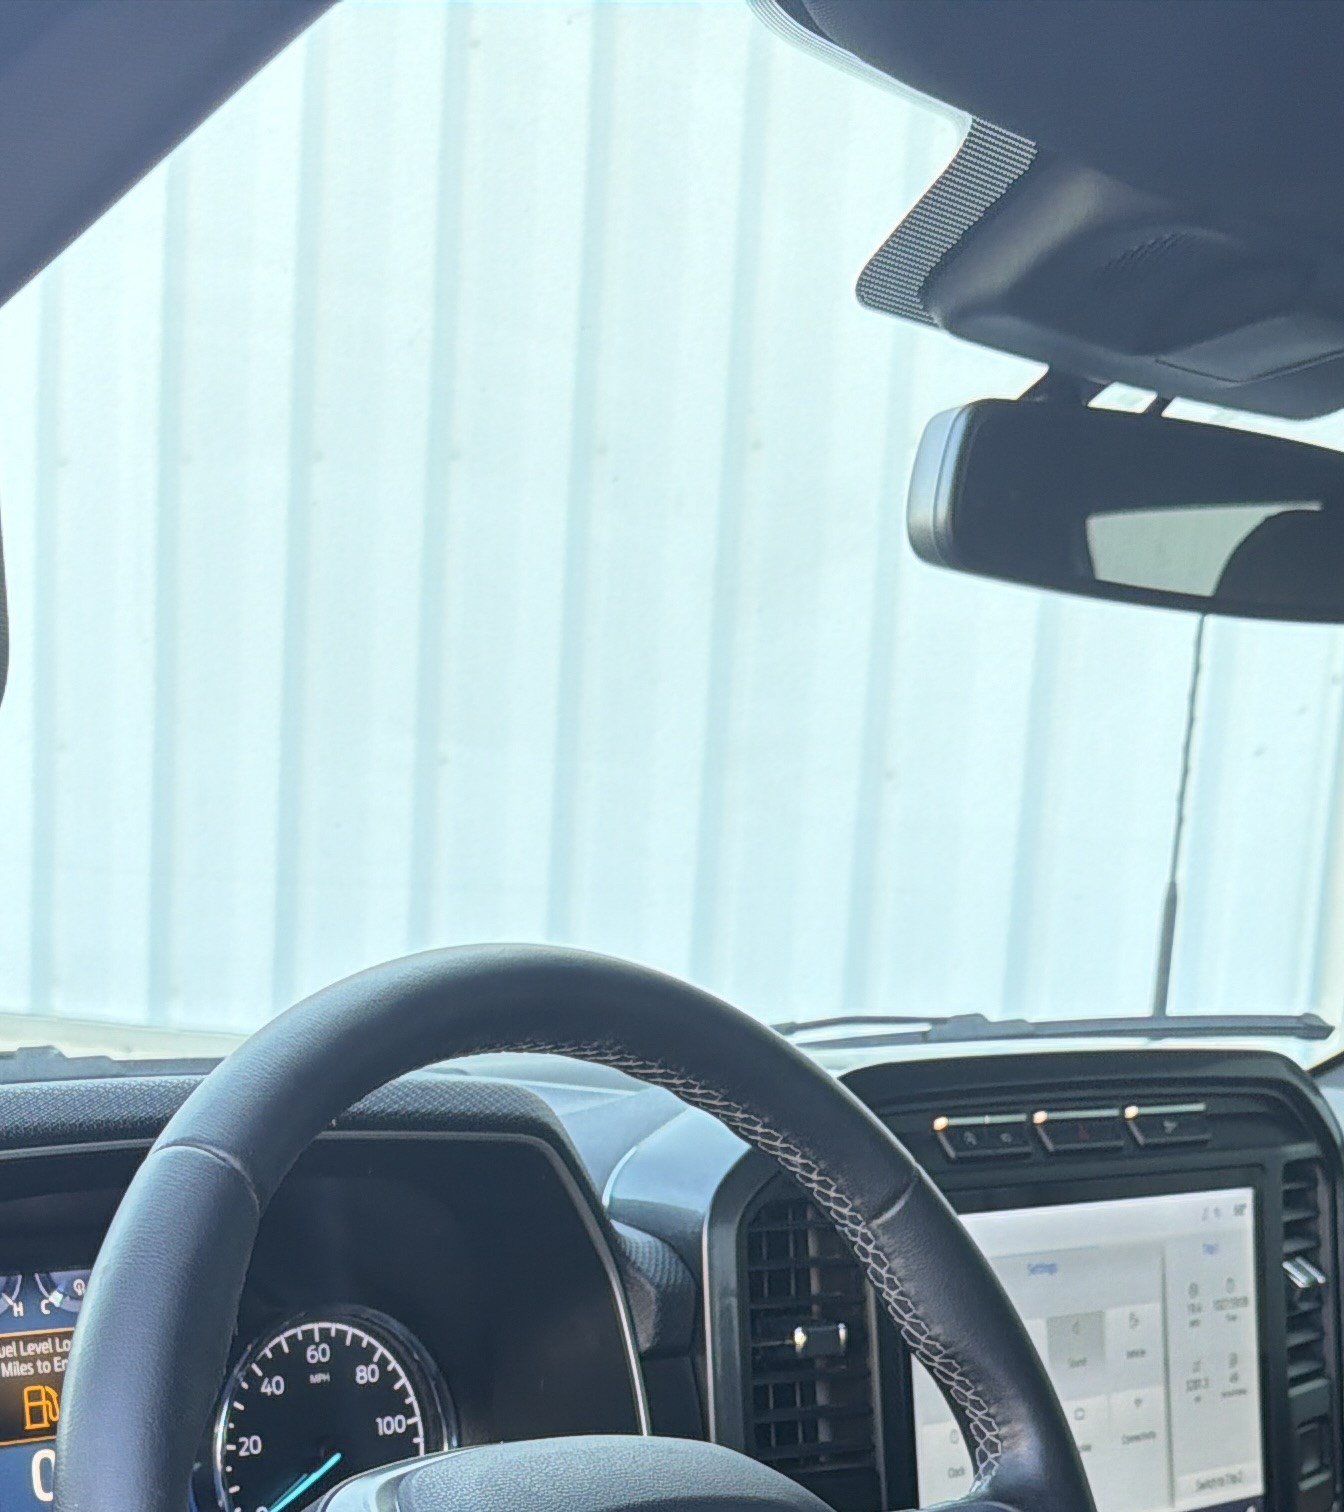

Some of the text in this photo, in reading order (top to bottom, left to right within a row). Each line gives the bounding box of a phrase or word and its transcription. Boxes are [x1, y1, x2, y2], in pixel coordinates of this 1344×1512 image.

[13, 1302, 24, 1317] H
[40, 1300, 51, 1315] C
[19, 1338, 53, 1356] Level
[55, 1337, 71, 1352] Lo
[306, 1343, 331, 1364] 60
[0, 1361, 35, 1377] Miles
[36, 1359, 52, 1374] to
[309, 1372, 331, 1384] MPH
[356, 1364, 380, 1385] 80
[260, 1375, 285, 1396] 40
[375, 1414, 406, 1436] 100
[238, 1435, 262, 1457] 20
